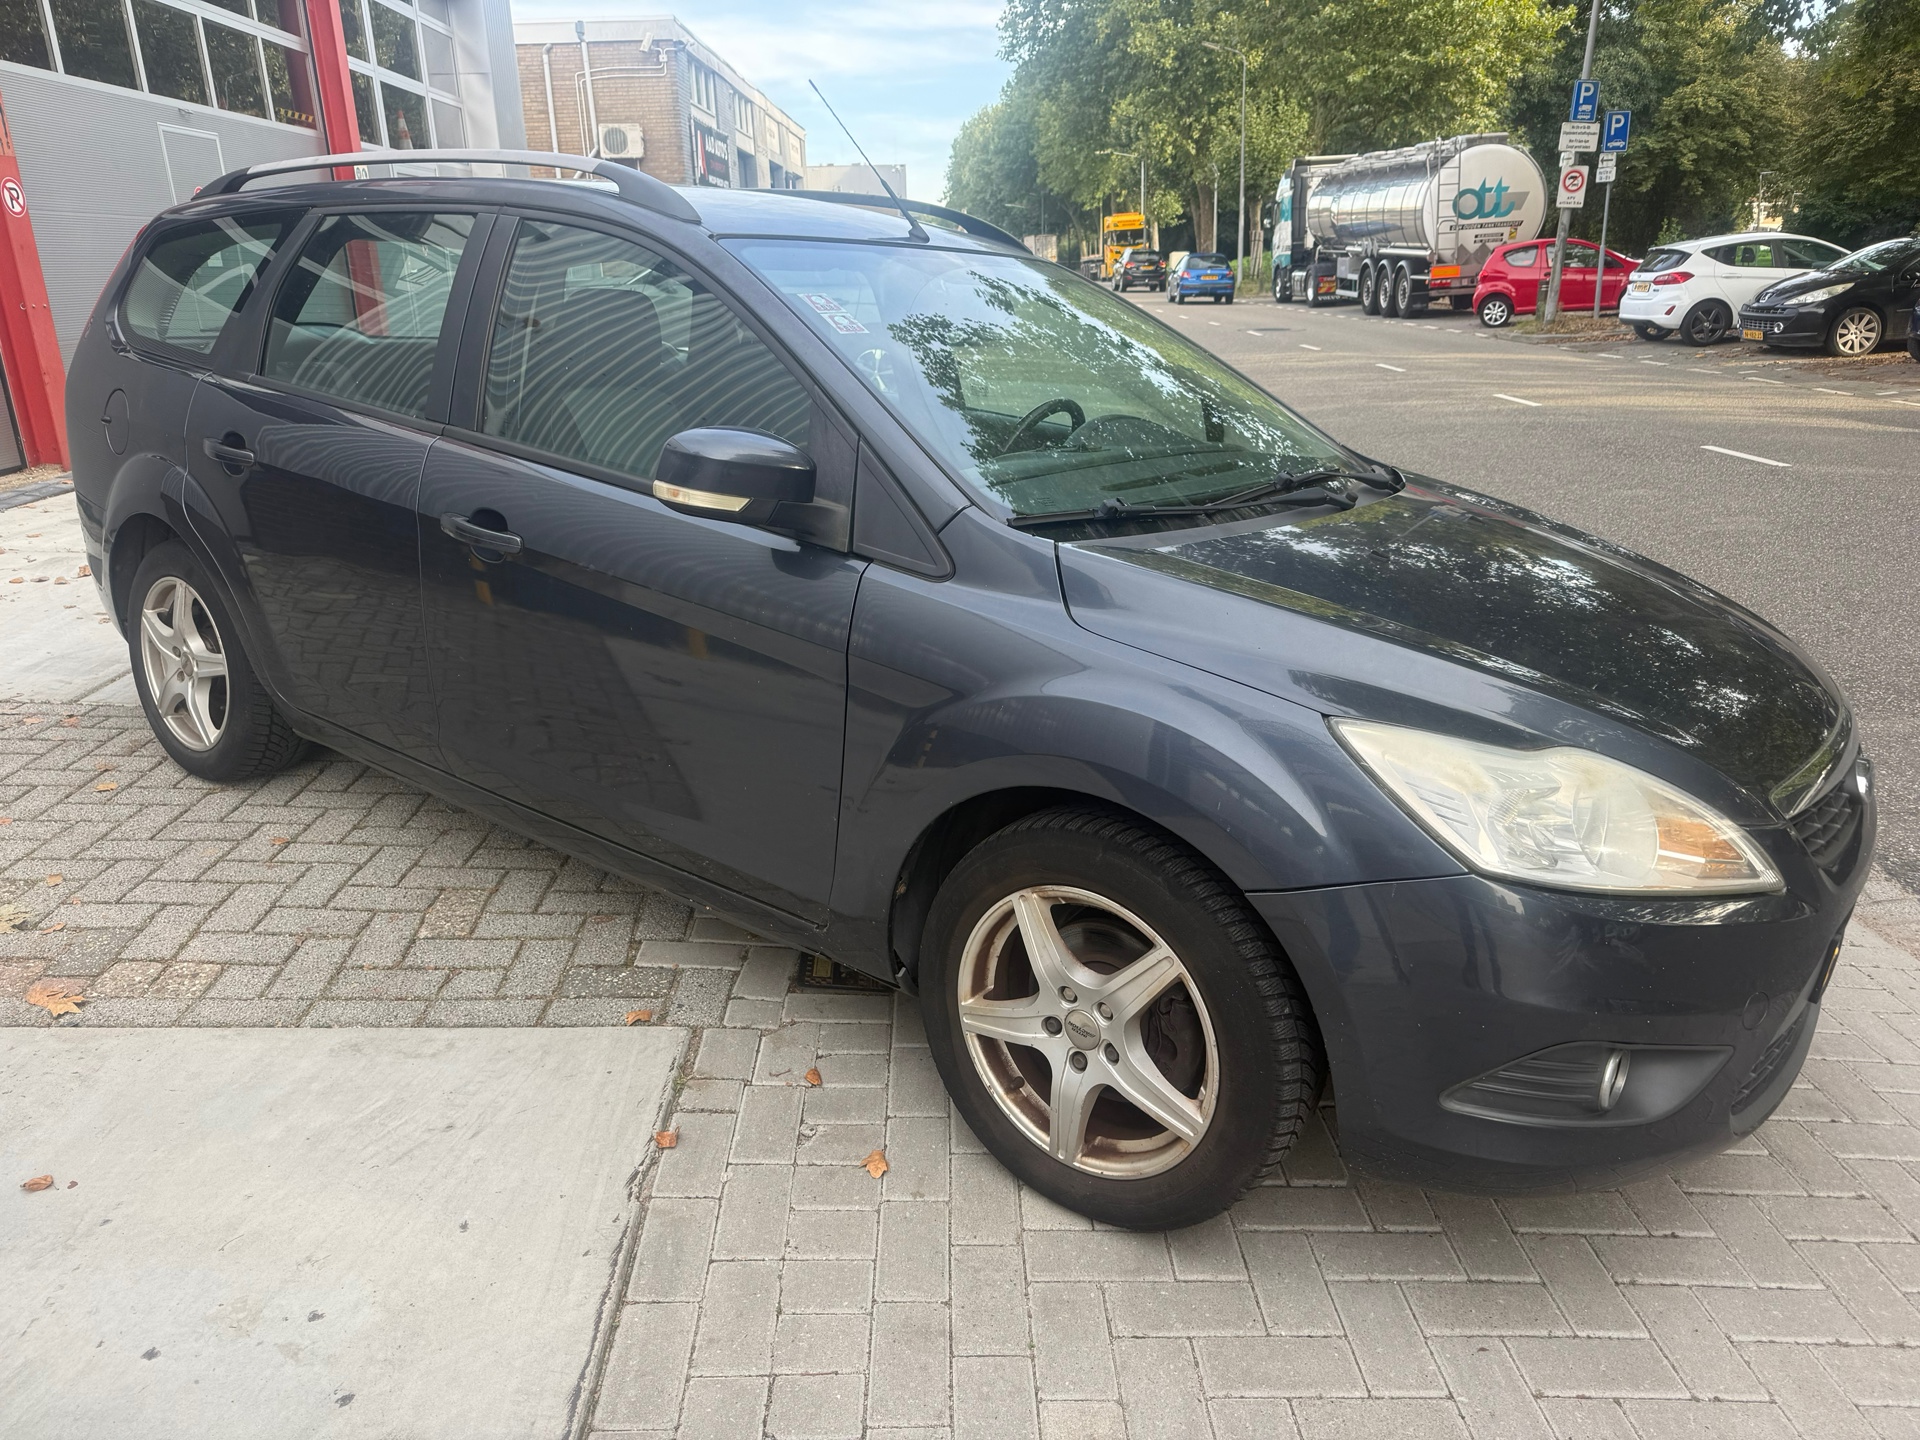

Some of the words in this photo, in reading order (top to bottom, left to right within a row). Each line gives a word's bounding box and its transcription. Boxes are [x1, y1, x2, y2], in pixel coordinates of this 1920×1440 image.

[1580, 83, 1594, 104] P
[1611, 114, 1625, 135] P
[1452, 175, 1515, 220] ott
